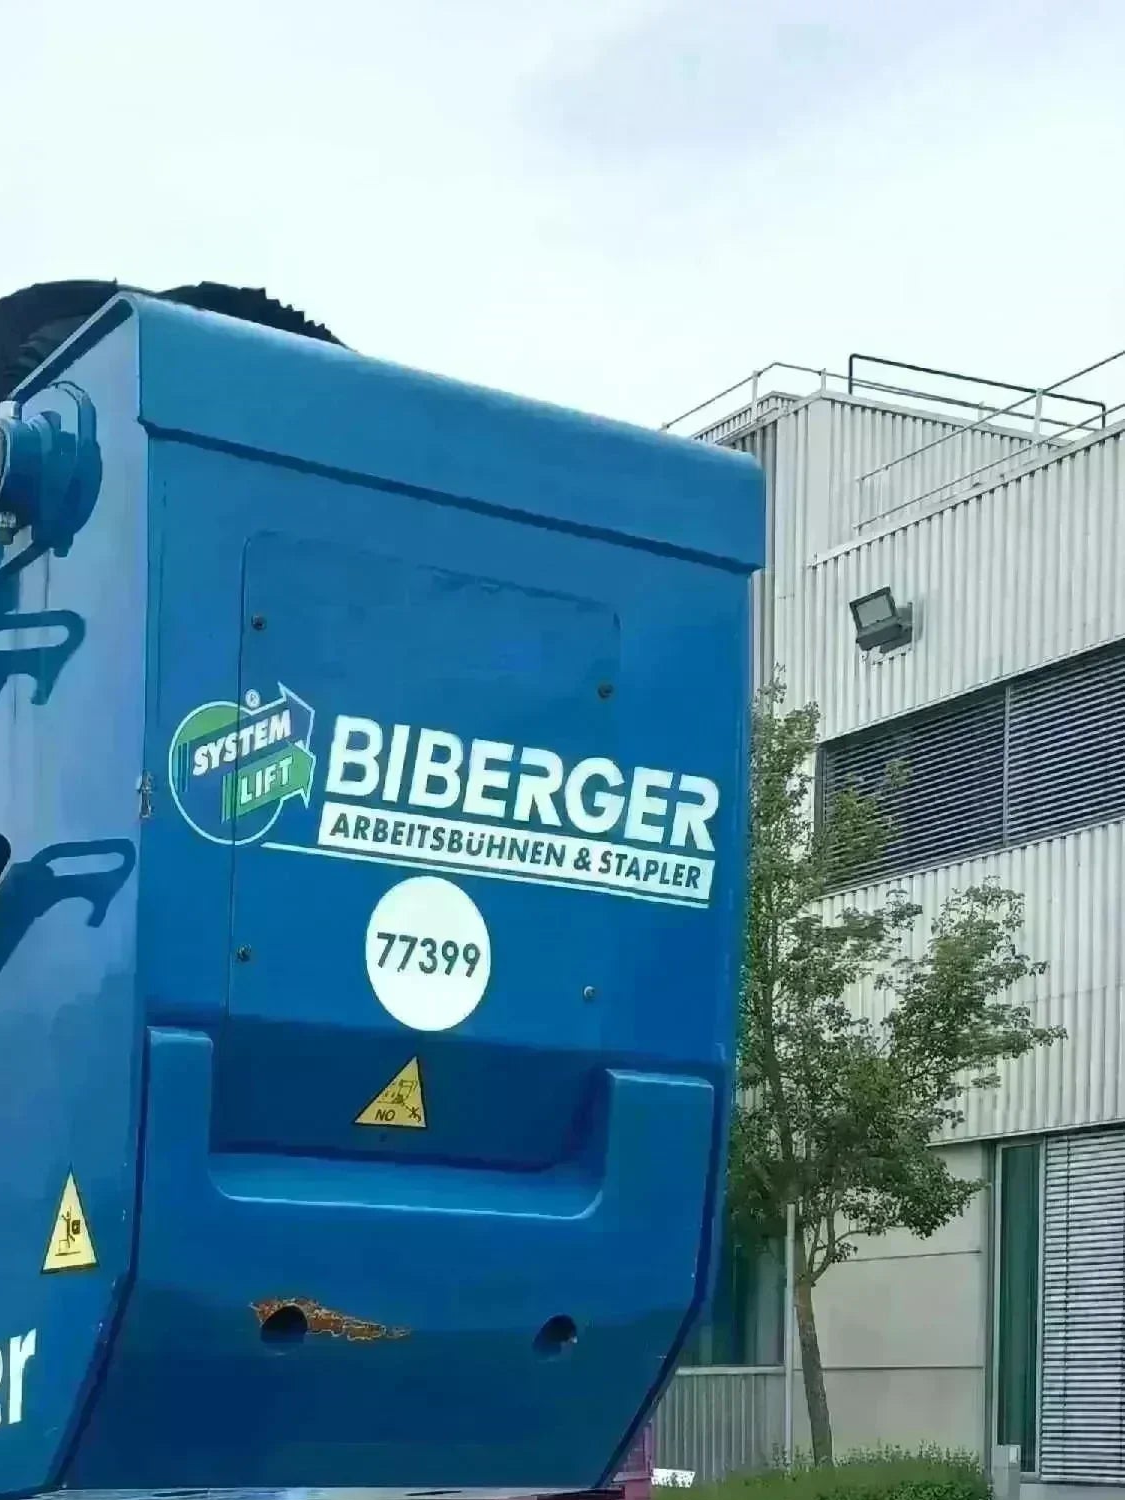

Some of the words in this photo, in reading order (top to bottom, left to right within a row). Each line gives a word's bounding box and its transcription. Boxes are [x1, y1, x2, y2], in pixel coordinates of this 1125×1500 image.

[192, 708, 292, 777] SYSTEM
[240, 755, 294, 805] LIFT
[324, 713, 720, 853] BIBERGER
[329, 811, 566, 869] ARBEITSBÜHNEN
[572, 847, 592, 873] &
[597, 850, 702, 891] STAPLER
[376, 931, 481, 979] 77399
[375, 1108, 396, 1122] NO
